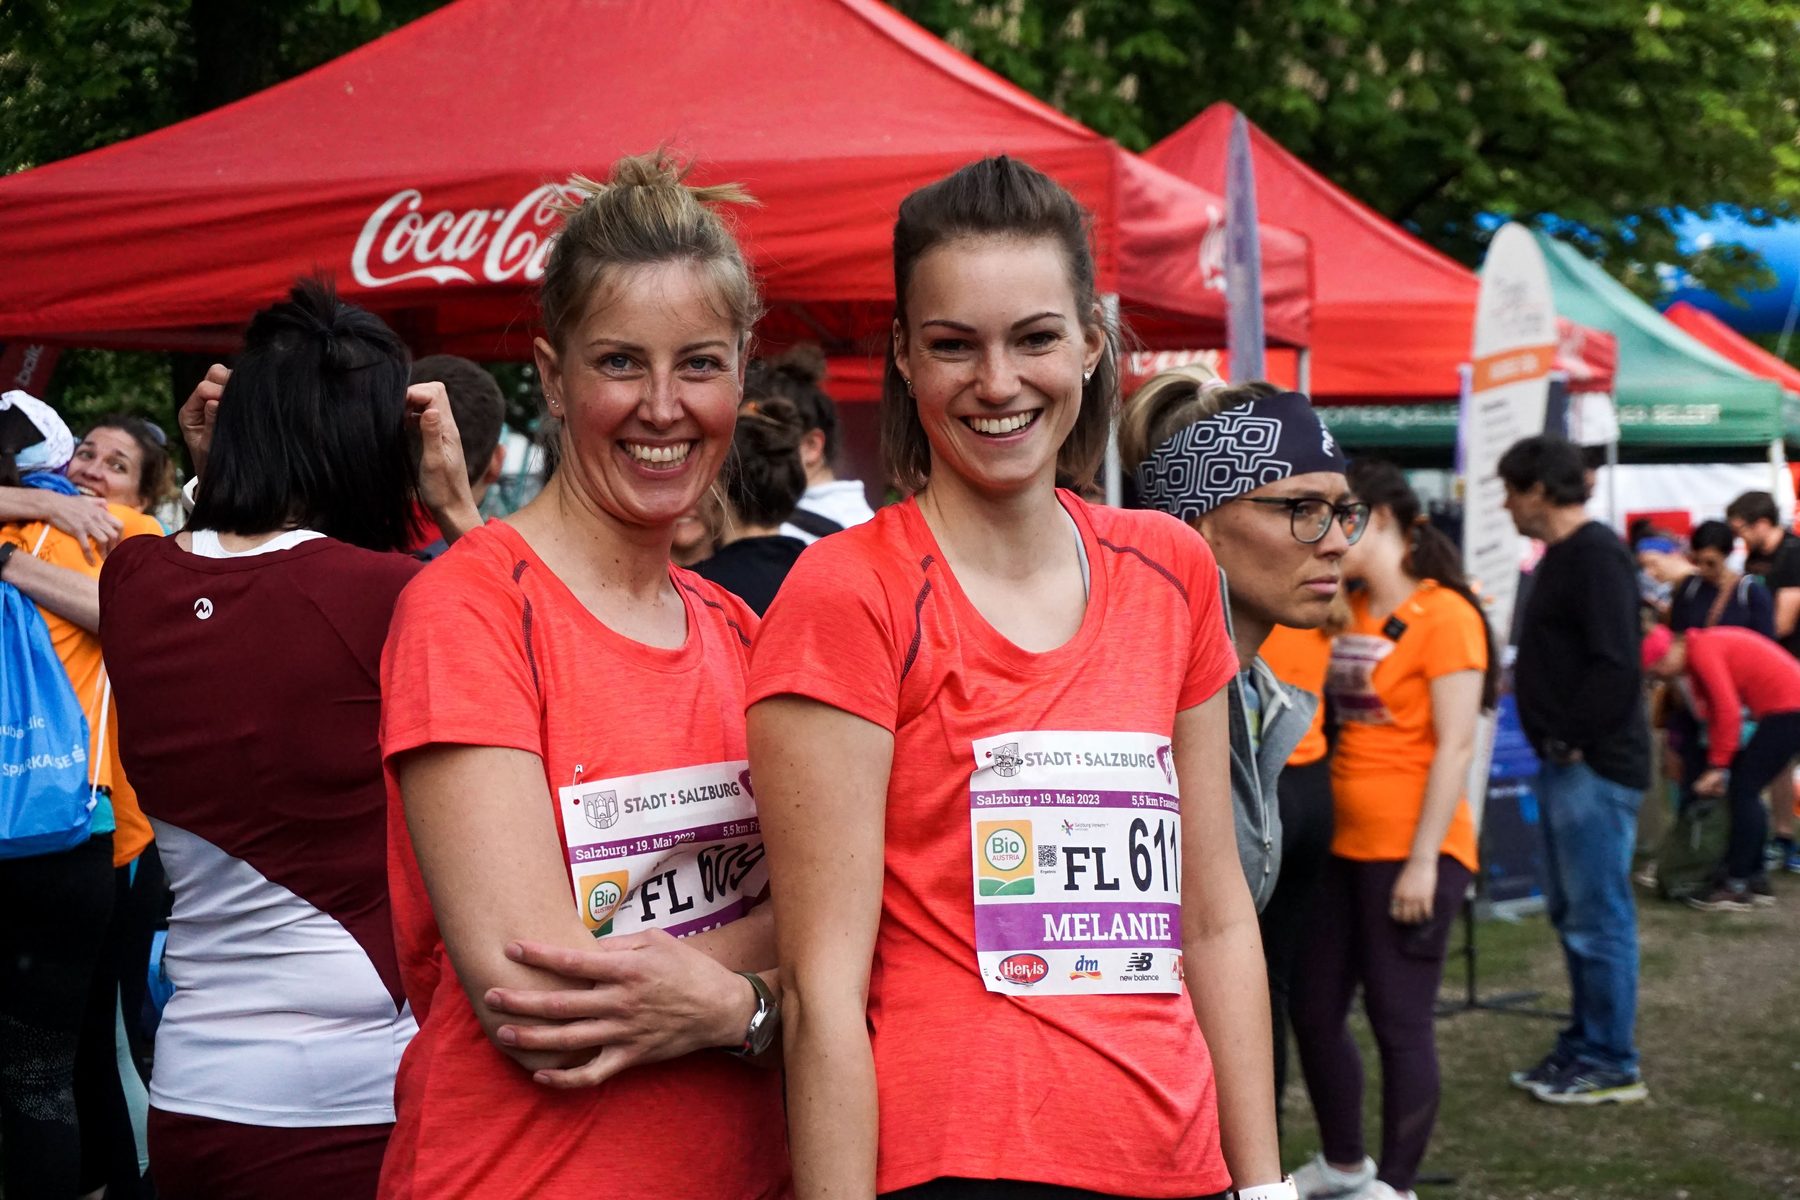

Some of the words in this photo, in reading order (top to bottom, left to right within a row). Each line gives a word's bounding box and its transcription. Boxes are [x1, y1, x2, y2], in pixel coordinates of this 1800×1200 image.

[1024, 751, 1072, 767] STADT
[1083, 752, 1155, 769] SALZBURG
[623, 793, 667, 814] STADT
[678, 781, 740, 805] SALZBURG
[976, 793, 1031, 806] Salzburg
[1040, 793, 1054, 804] 19.
[1056, 793, 1075, 804] Mai
[1076, 794, 1100, 805] 2023
[1131, 795, 1145, 807] 5,5
[1145, 795, 1158, 806] km
[723, 824, 735, 837] 5,5
[735, 823, 749, 834] km
[575, 845, 628, 861] Salzburg
[636, 840, 651, 852] 19.
[653, 835, 673, 849] Mai
[992, 837, 1019, 854] Bio
[991, 853, 1020, 861] AUSTRIA
[1062, 847, 1120, 891] FL
[594, 889, 617, 908] Bio
[641, 869, 694, 922] FL
[1042, 913, 1172, 941] MELANIE
[1003, 961, 1045, 978] Hervis
[1075, 954, 1099, 972] dm
